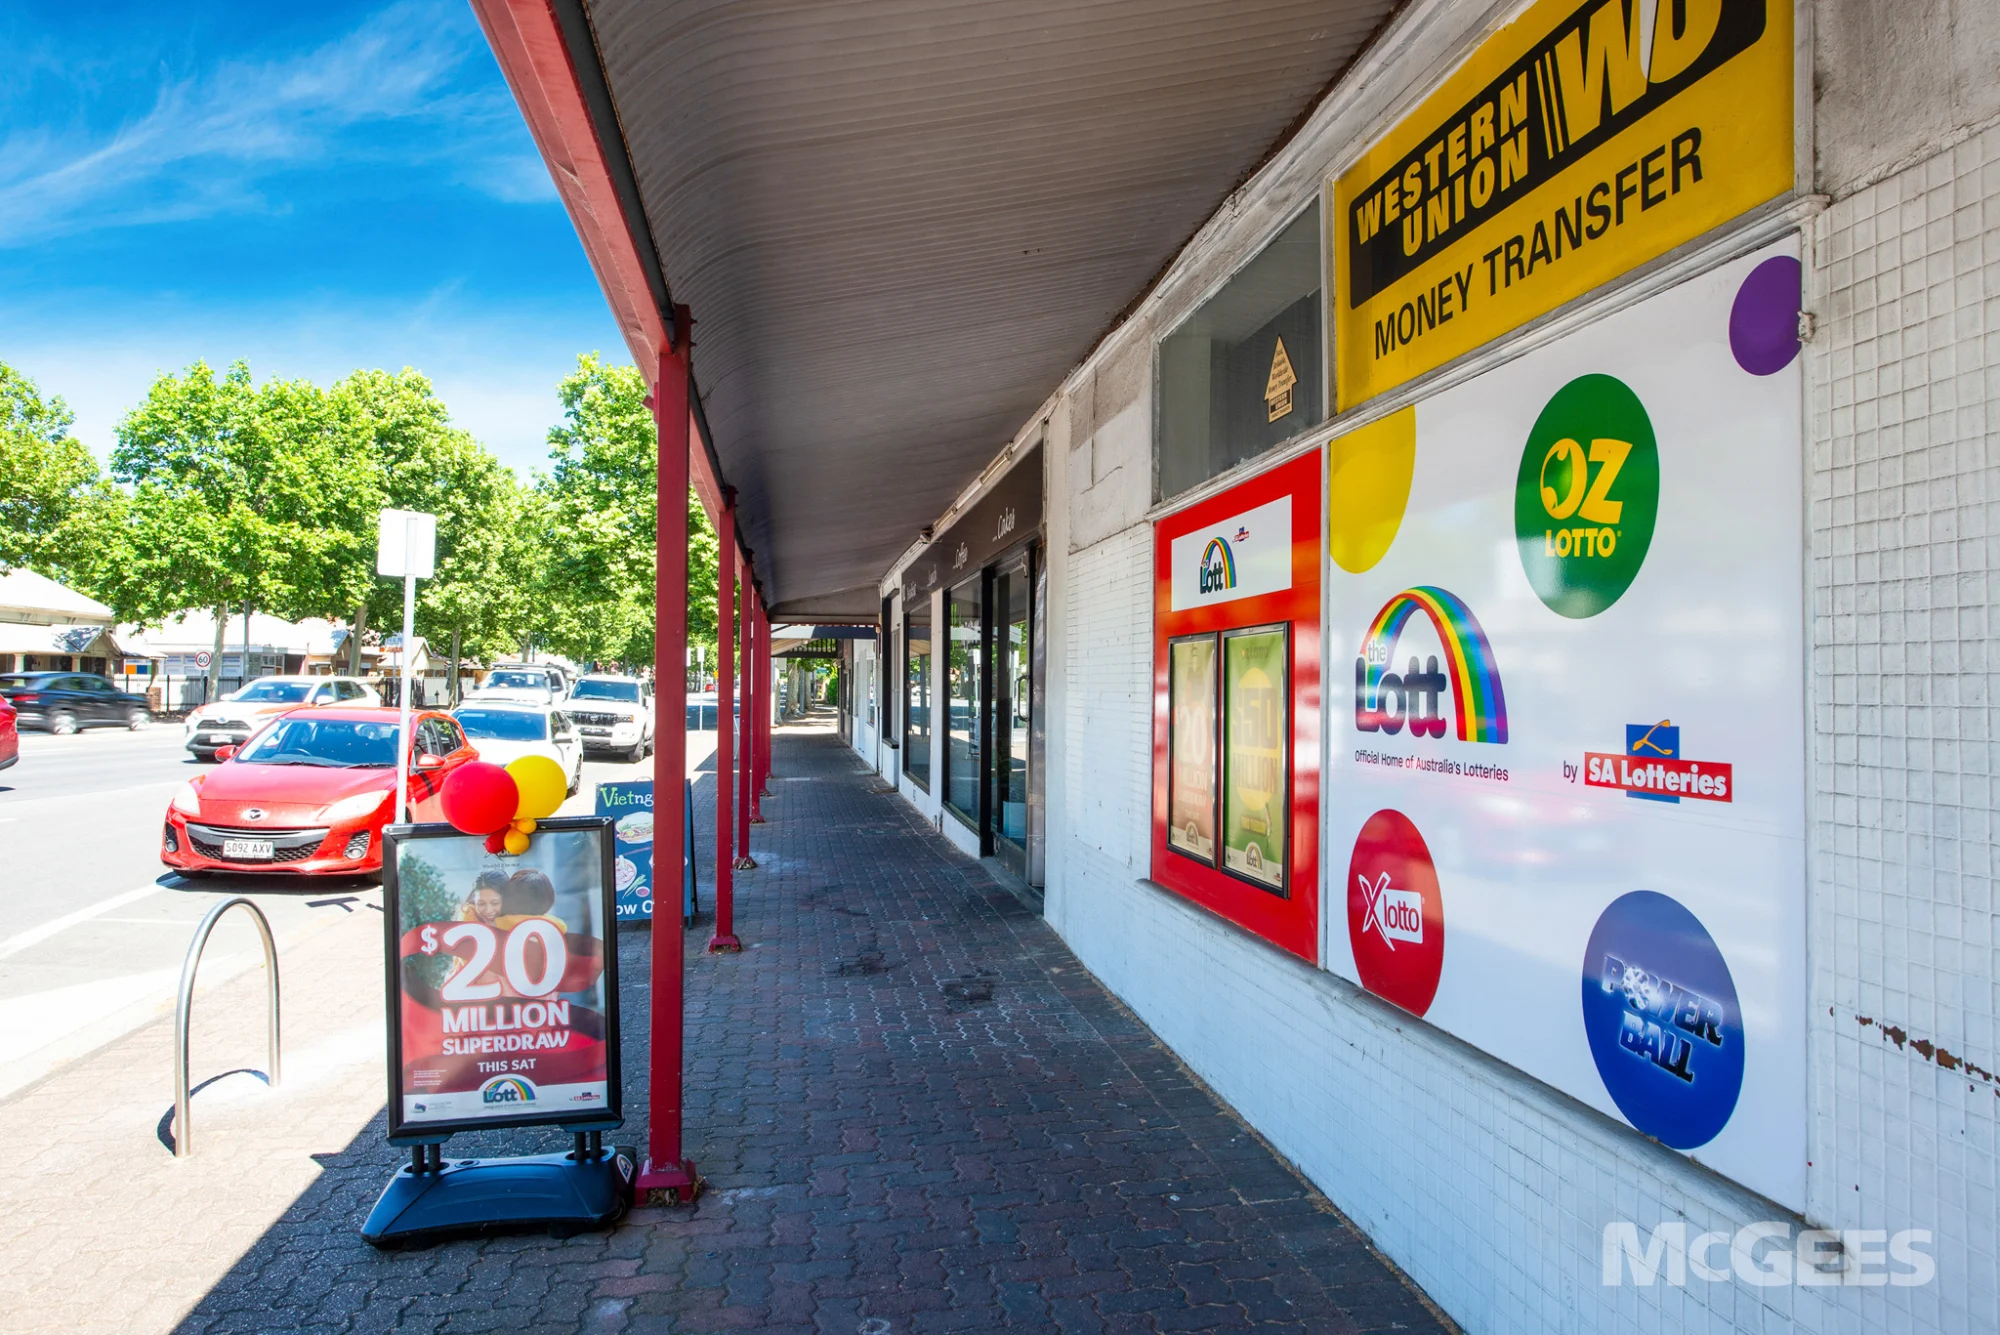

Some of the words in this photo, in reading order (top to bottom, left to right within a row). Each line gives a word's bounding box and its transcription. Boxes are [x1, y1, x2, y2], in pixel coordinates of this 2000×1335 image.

[1356, 70, 1528, 246] WESTERN
[1401, 127, 1529, 257] UNION
[1375, 264, 1474, 361] MONEY
[1483, 126, 1704, 297] TRANSFER
[1540, 438, 1633, 524] OZ
[1545, 527, 1616, 558] LOTTO
[1200, 561, 1223, 594] Lott
[198, 655, 209, 664] 60
[1367, 639, 1386, 664] the
[1355, 655, 1446, 739] Lott
[1355, 749, 1379, 766] Official
[1381, 754, 1403, 768] Home
[1405, 755, 1414, 769] of
[1416, 756, 1461, 775] Australia's
[1463, 761, 1509, 782] Lotteries
[1563, 760, 1578, 783] by
[1589, 757, 1615, 783] SA
[1621, 759, 1727, 797] Lotteries
[600, 787, 653, 807] Vietng
[253, 844, 272, 853] AXV
[616, 904, 637, 915] ow
[442, 1000, 571, 1033] MILLION
[1601, 954, 1724, 1047] POWER
[442, 1030, 570, 1056] SUPERDRAW
[1619, 1010, 1694, 1083] BALL
[477, 1061, 509, 1073] THIS
[511, 1058, 537, 1071] SAT
[483, 1088, 517, 1103] Lott
